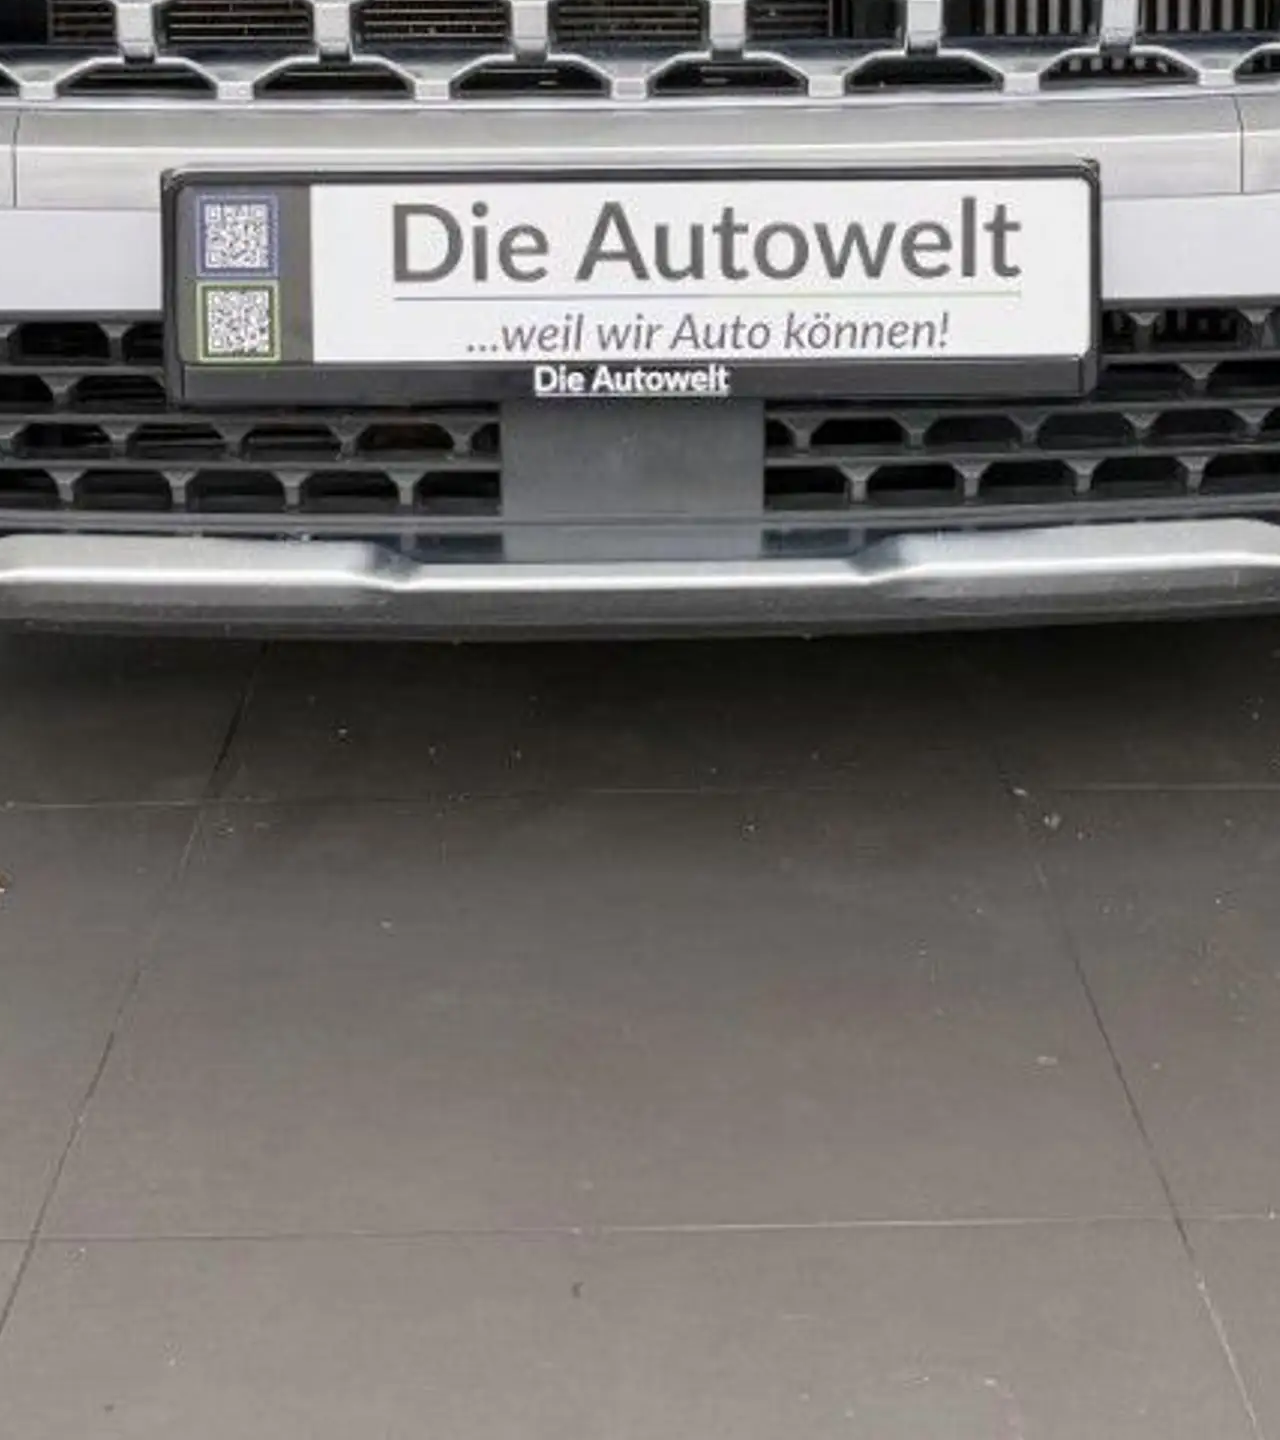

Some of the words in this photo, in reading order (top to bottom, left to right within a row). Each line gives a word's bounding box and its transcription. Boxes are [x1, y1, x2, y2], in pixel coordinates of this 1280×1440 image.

[393, 201, 550, 283] Die
[575, 196, 1022, 281] Autowelt
[466, 313, 585, 353] ...weil
[597, 313, 664, 351] wir
[667, 313, 771, 351] Auto
[783, 311, 950, 350] können!
[534, 363, 585, 393] Die
[590, 363, 730, 393] Autowelt
